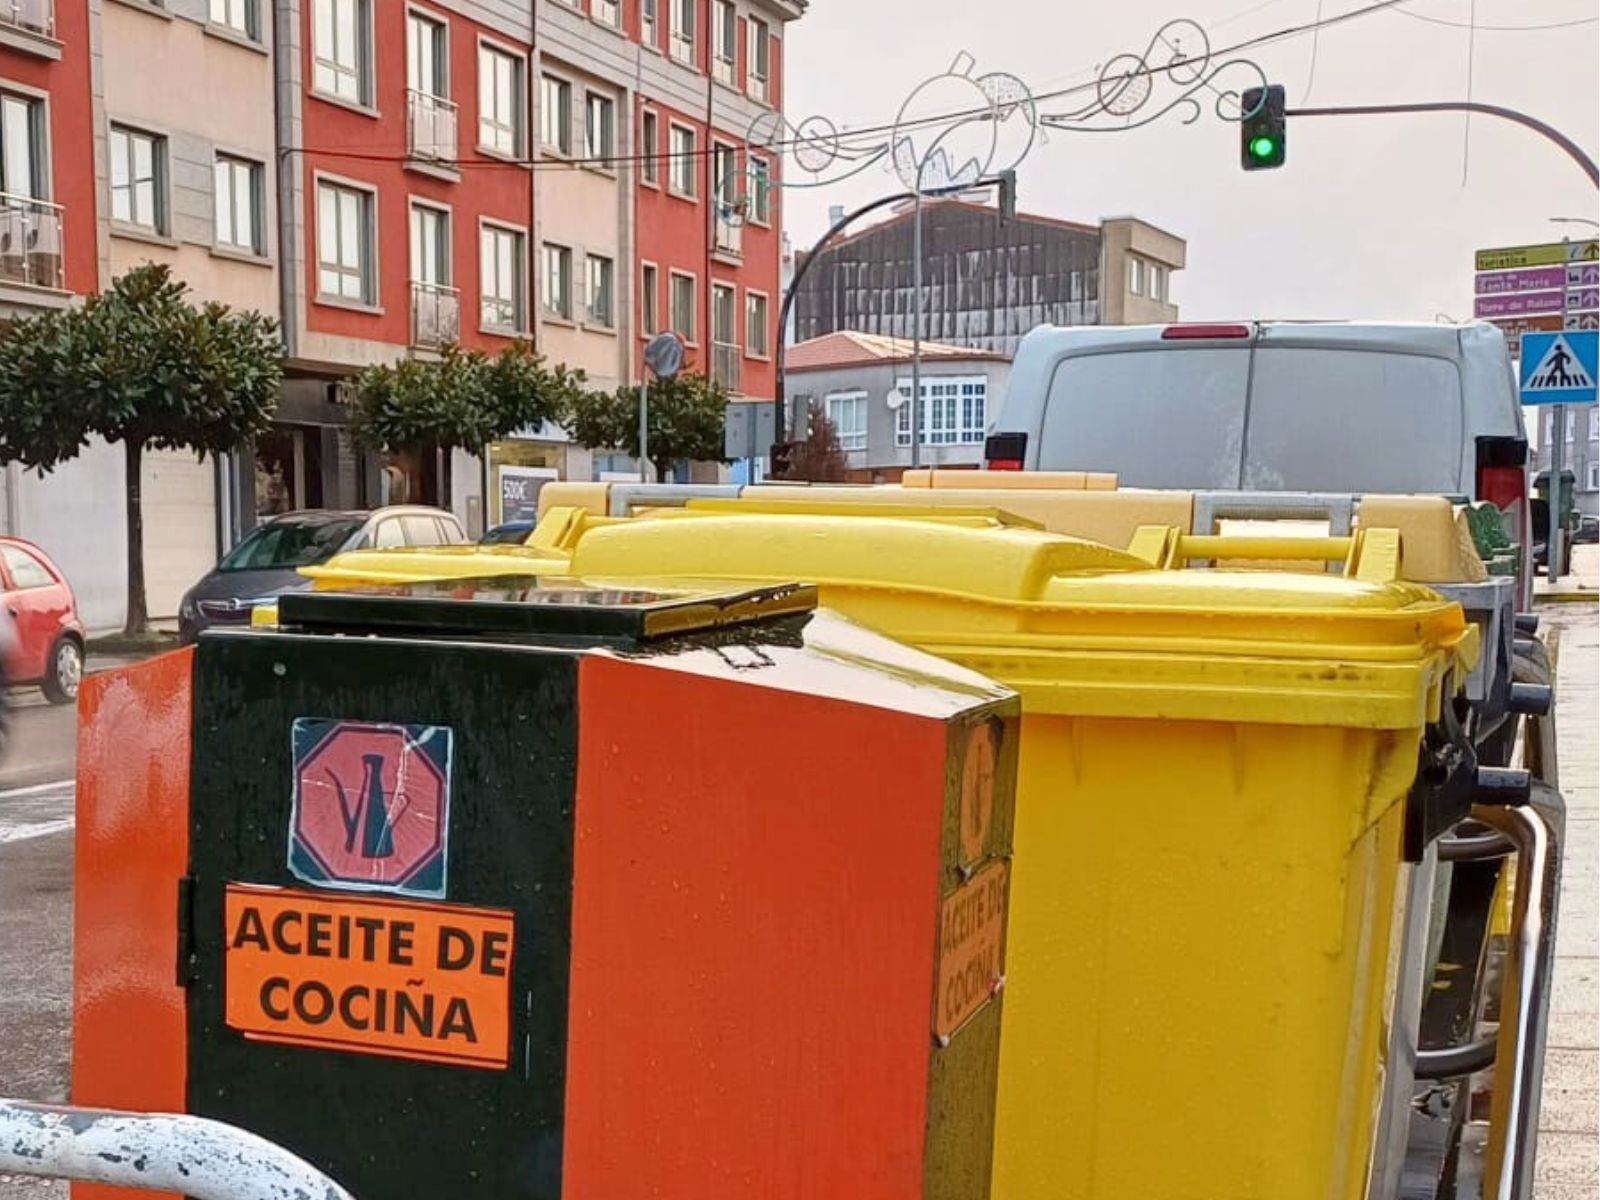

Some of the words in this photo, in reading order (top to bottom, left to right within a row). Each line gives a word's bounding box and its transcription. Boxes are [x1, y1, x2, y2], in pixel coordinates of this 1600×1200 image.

[232, 907, 415, 966] ACEITE
[436, 925, 509, 977] DE
[942, 884, 985, 953] ACEITE
[259, 977, 478, 1044] COCIÑA
